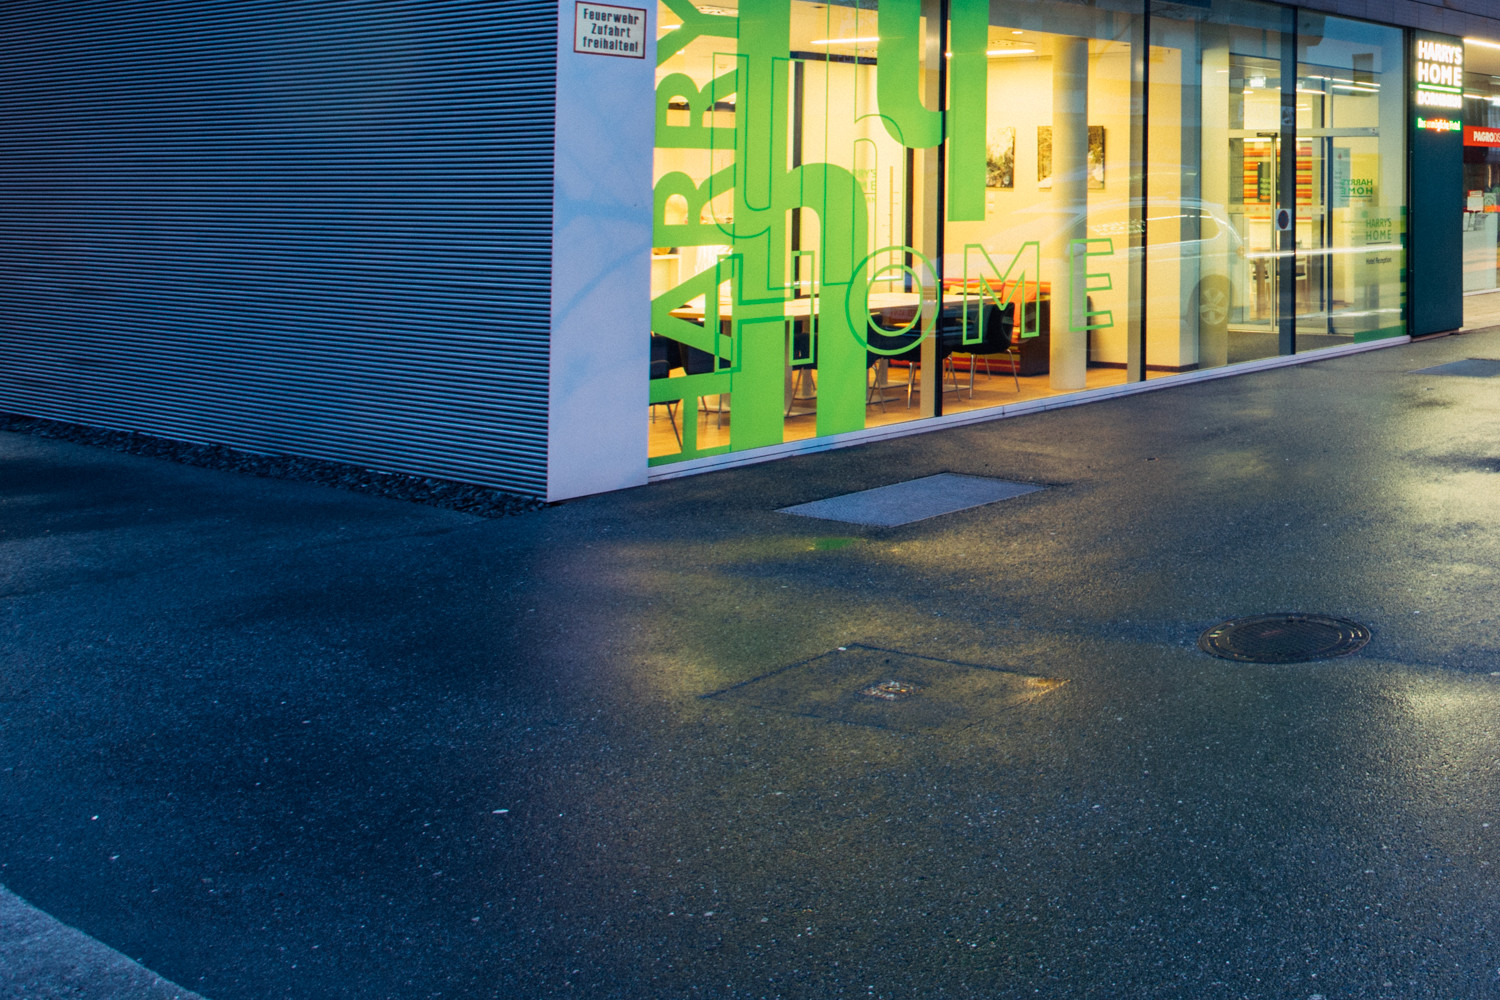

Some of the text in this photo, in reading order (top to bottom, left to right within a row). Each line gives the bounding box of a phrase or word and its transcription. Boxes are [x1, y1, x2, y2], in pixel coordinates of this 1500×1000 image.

[583, 8, 640, 25] Feuerwehr
[591, 23, 631, 38] Zufahrt
[583, 36, 639, 52] freihalten!
[1417, 61, 1463, 88] HOME
[1366, 229, 1392, 241] HOME
